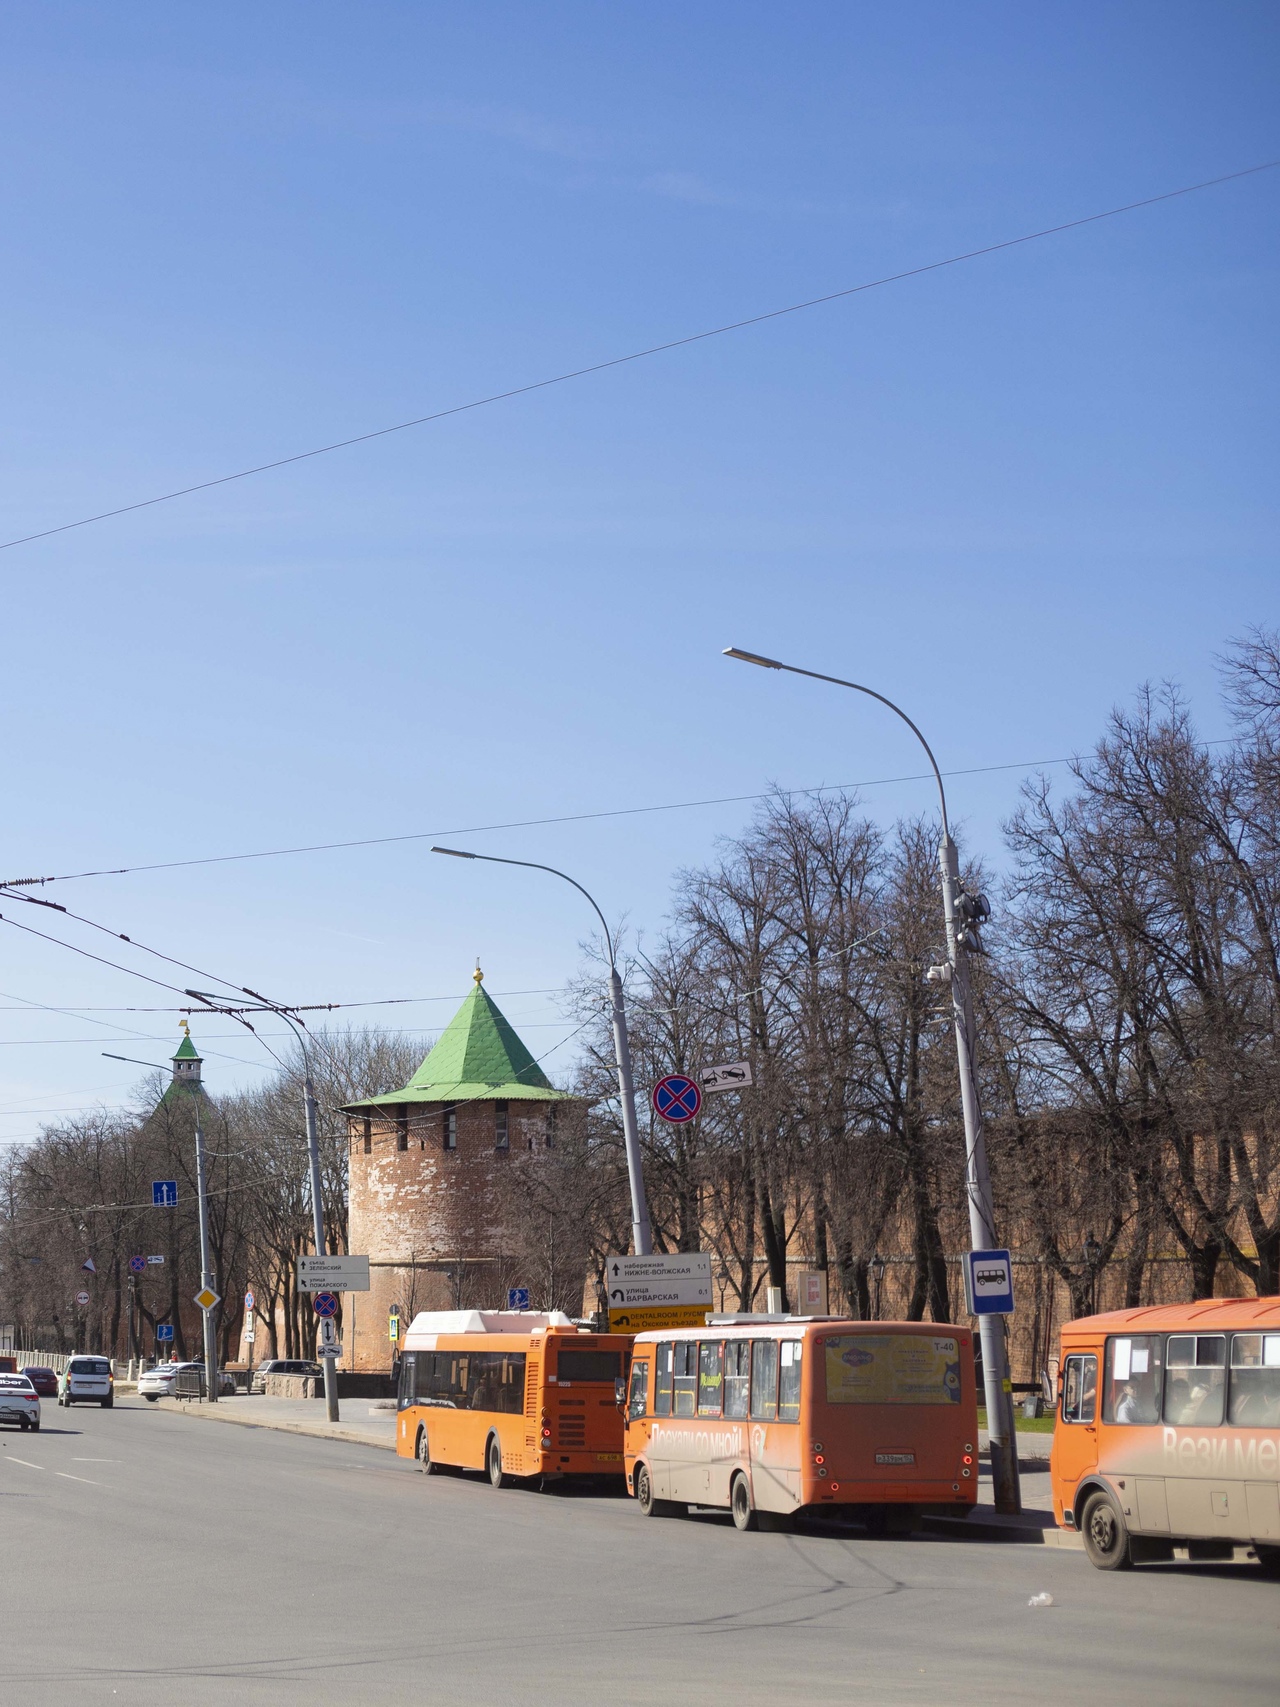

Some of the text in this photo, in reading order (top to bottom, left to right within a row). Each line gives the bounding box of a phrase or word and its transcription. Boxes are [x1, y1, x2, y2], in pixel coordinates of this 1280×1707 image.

[623, 1262, 664, 1270] набережная
[697, 1263, 706, 1271] 1,1
[624, 1268, 691, 1276] НИЖНЕ-ВОЛЖСКАЯ
[626, 1294, 679, 1303] ВАРВАРСКАЯ
[630, 1312, 678, 1320] DENTALROOM
[641, 1320, 669, 1328] Окском
[651, 1423, 695, 1456] Поехали
[695, 1431, 709, 1456] со
[709, 1425, 742, 1458] мной!
[1163, 1426, 1280, 1476] Вези ме
